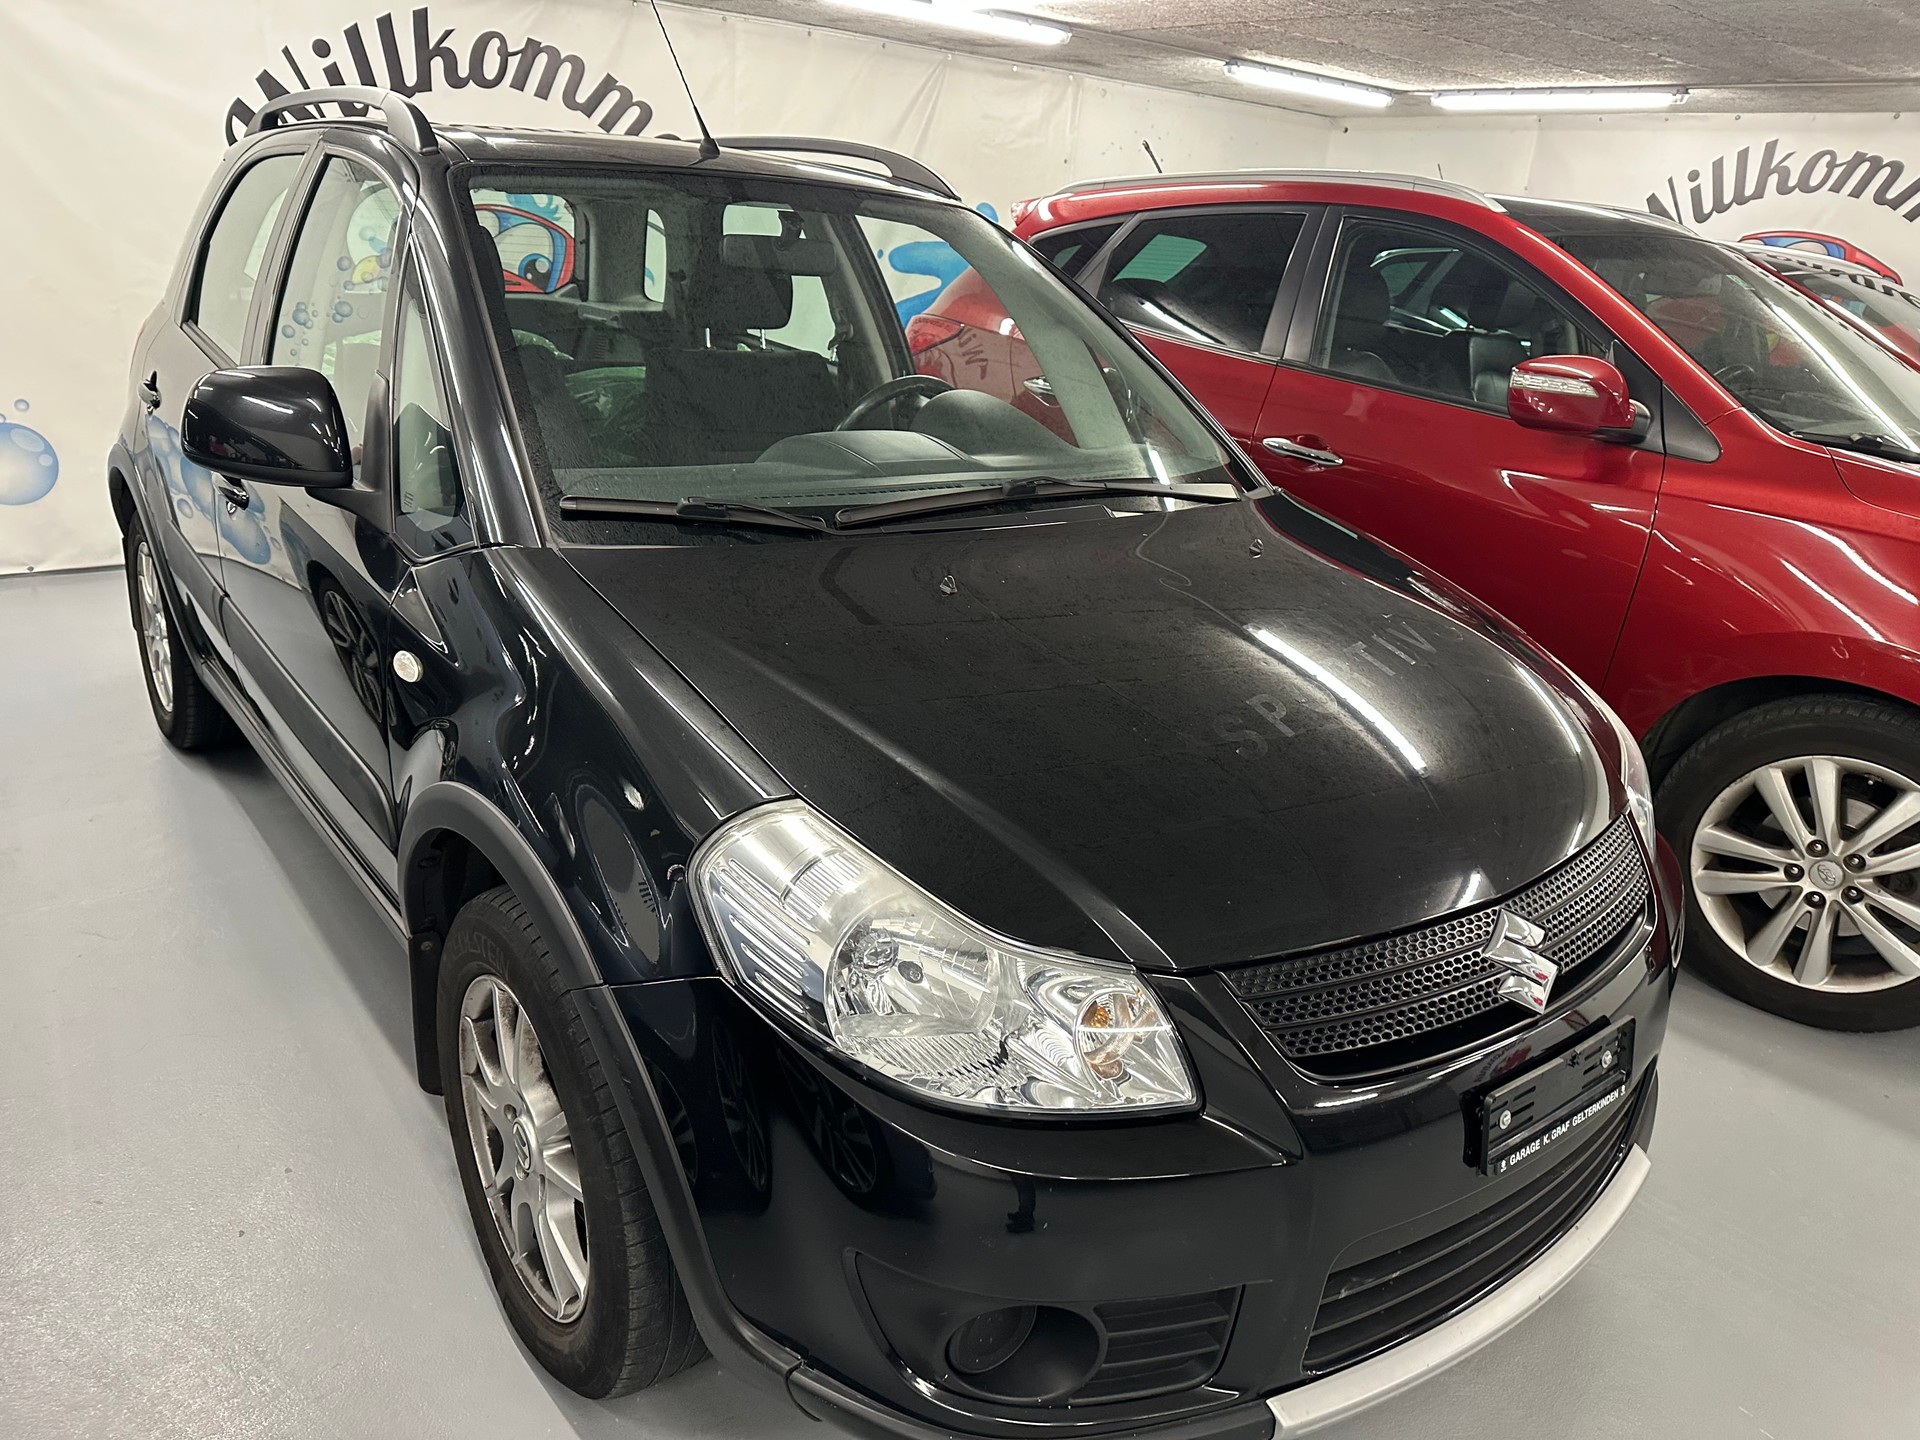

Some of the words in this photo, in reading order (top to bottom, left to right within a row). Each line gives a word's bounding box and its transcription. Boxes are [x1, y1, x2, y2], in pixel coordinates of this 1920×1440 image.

[1509, 1138, 1541, 1166] GARAGE
[1543, 1134, 1551, 1146] K.
[1551, 1120, 1570, 1141] GRAF
[1572, 1088, 1619, 1127] GELTERKINDEN
